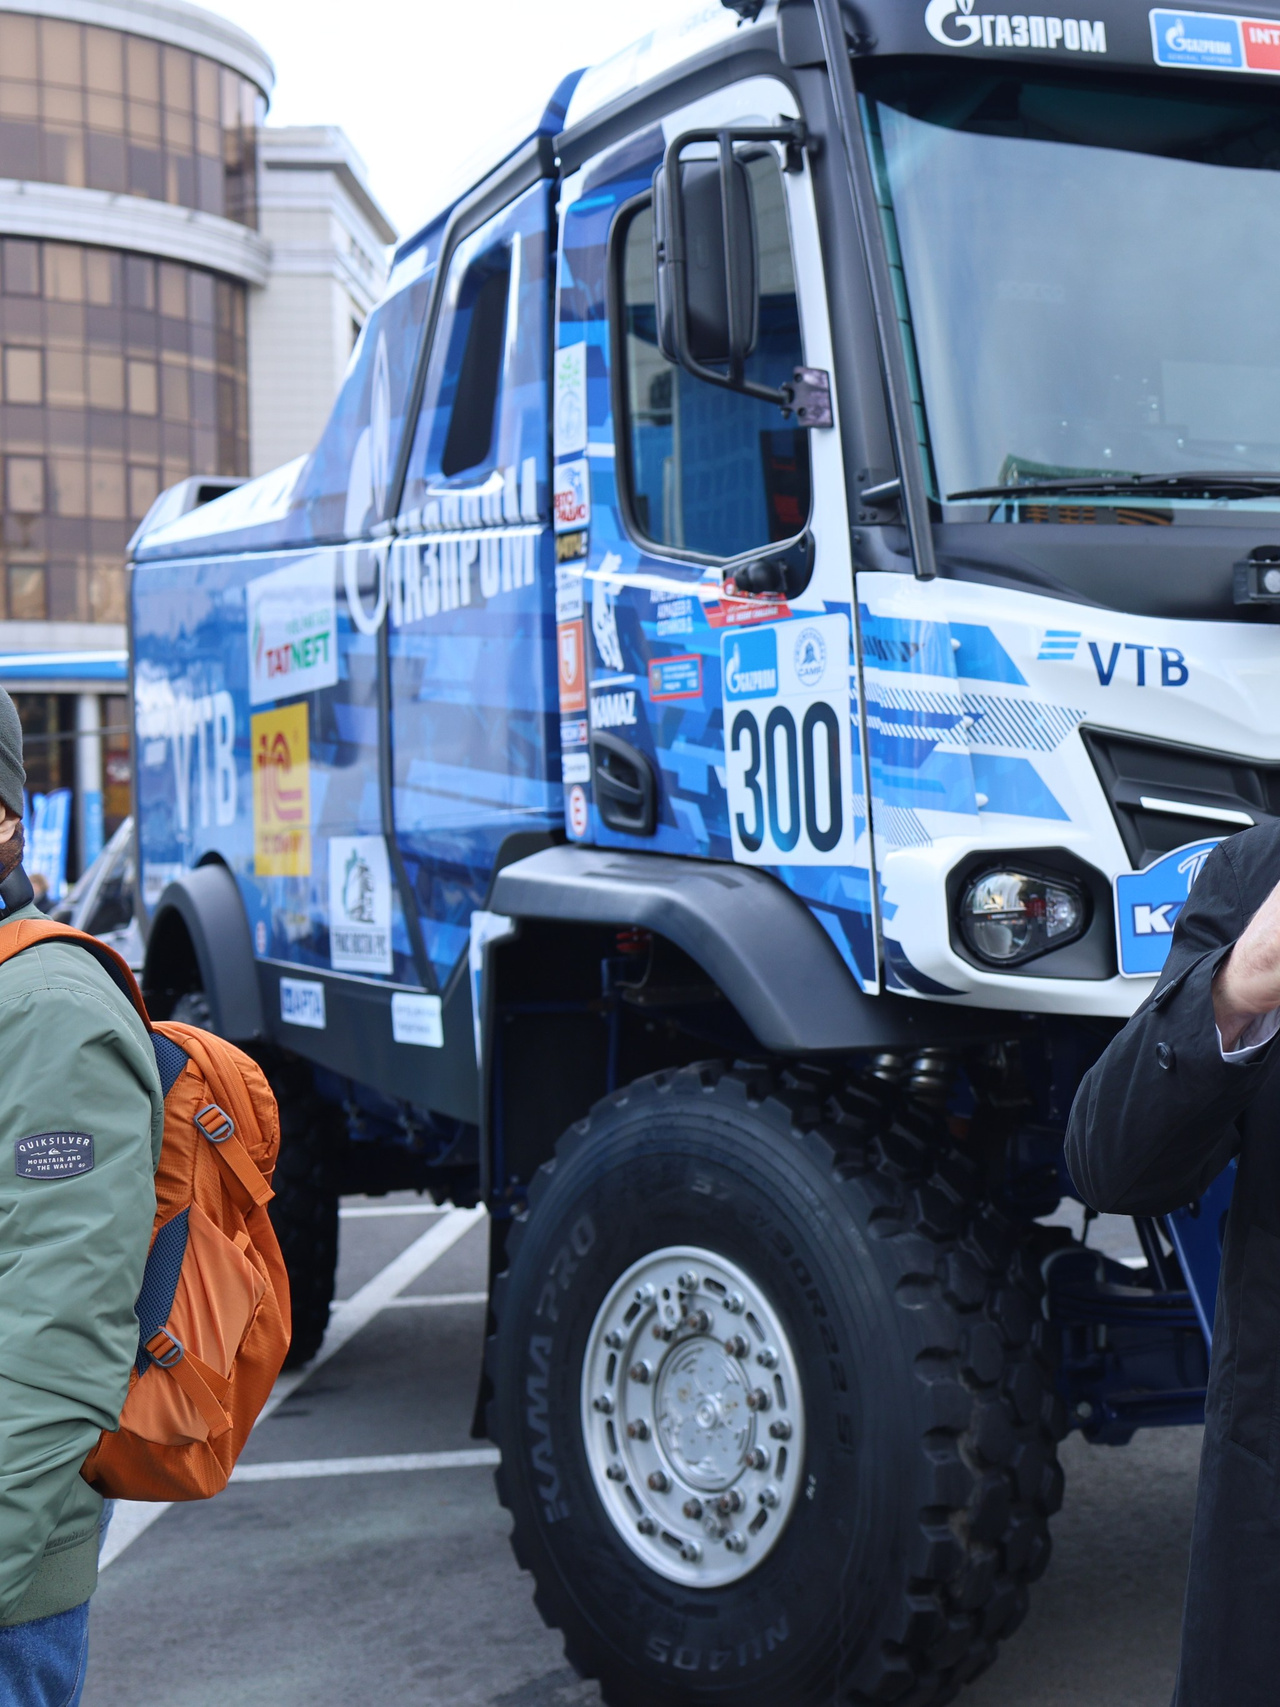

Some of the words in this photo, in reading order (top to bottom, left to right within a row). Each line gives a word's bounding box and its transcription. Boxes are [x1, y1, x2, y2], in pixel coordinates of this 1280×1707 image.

[982, 16, 1106, 53] ГАЗПРОМ
[390, 456, 543, 628] ГАЗПРОМ
[265, 629, 331, 679] TATNEFT
[1088, 641, 1190, 687] VTB
[740, 668, 777, 693] GAZPROM
[590, 691, 638, 730] KAMAZ
[168, 688, 239, 832] VTB
[731, 701, 843, 853] 300
[19, 1136, 91, 1152] QUIKSILVER
[27, 1156, 64, 1165] MOUNTAIN
[53, 1162, 74, 1171] WAVE
